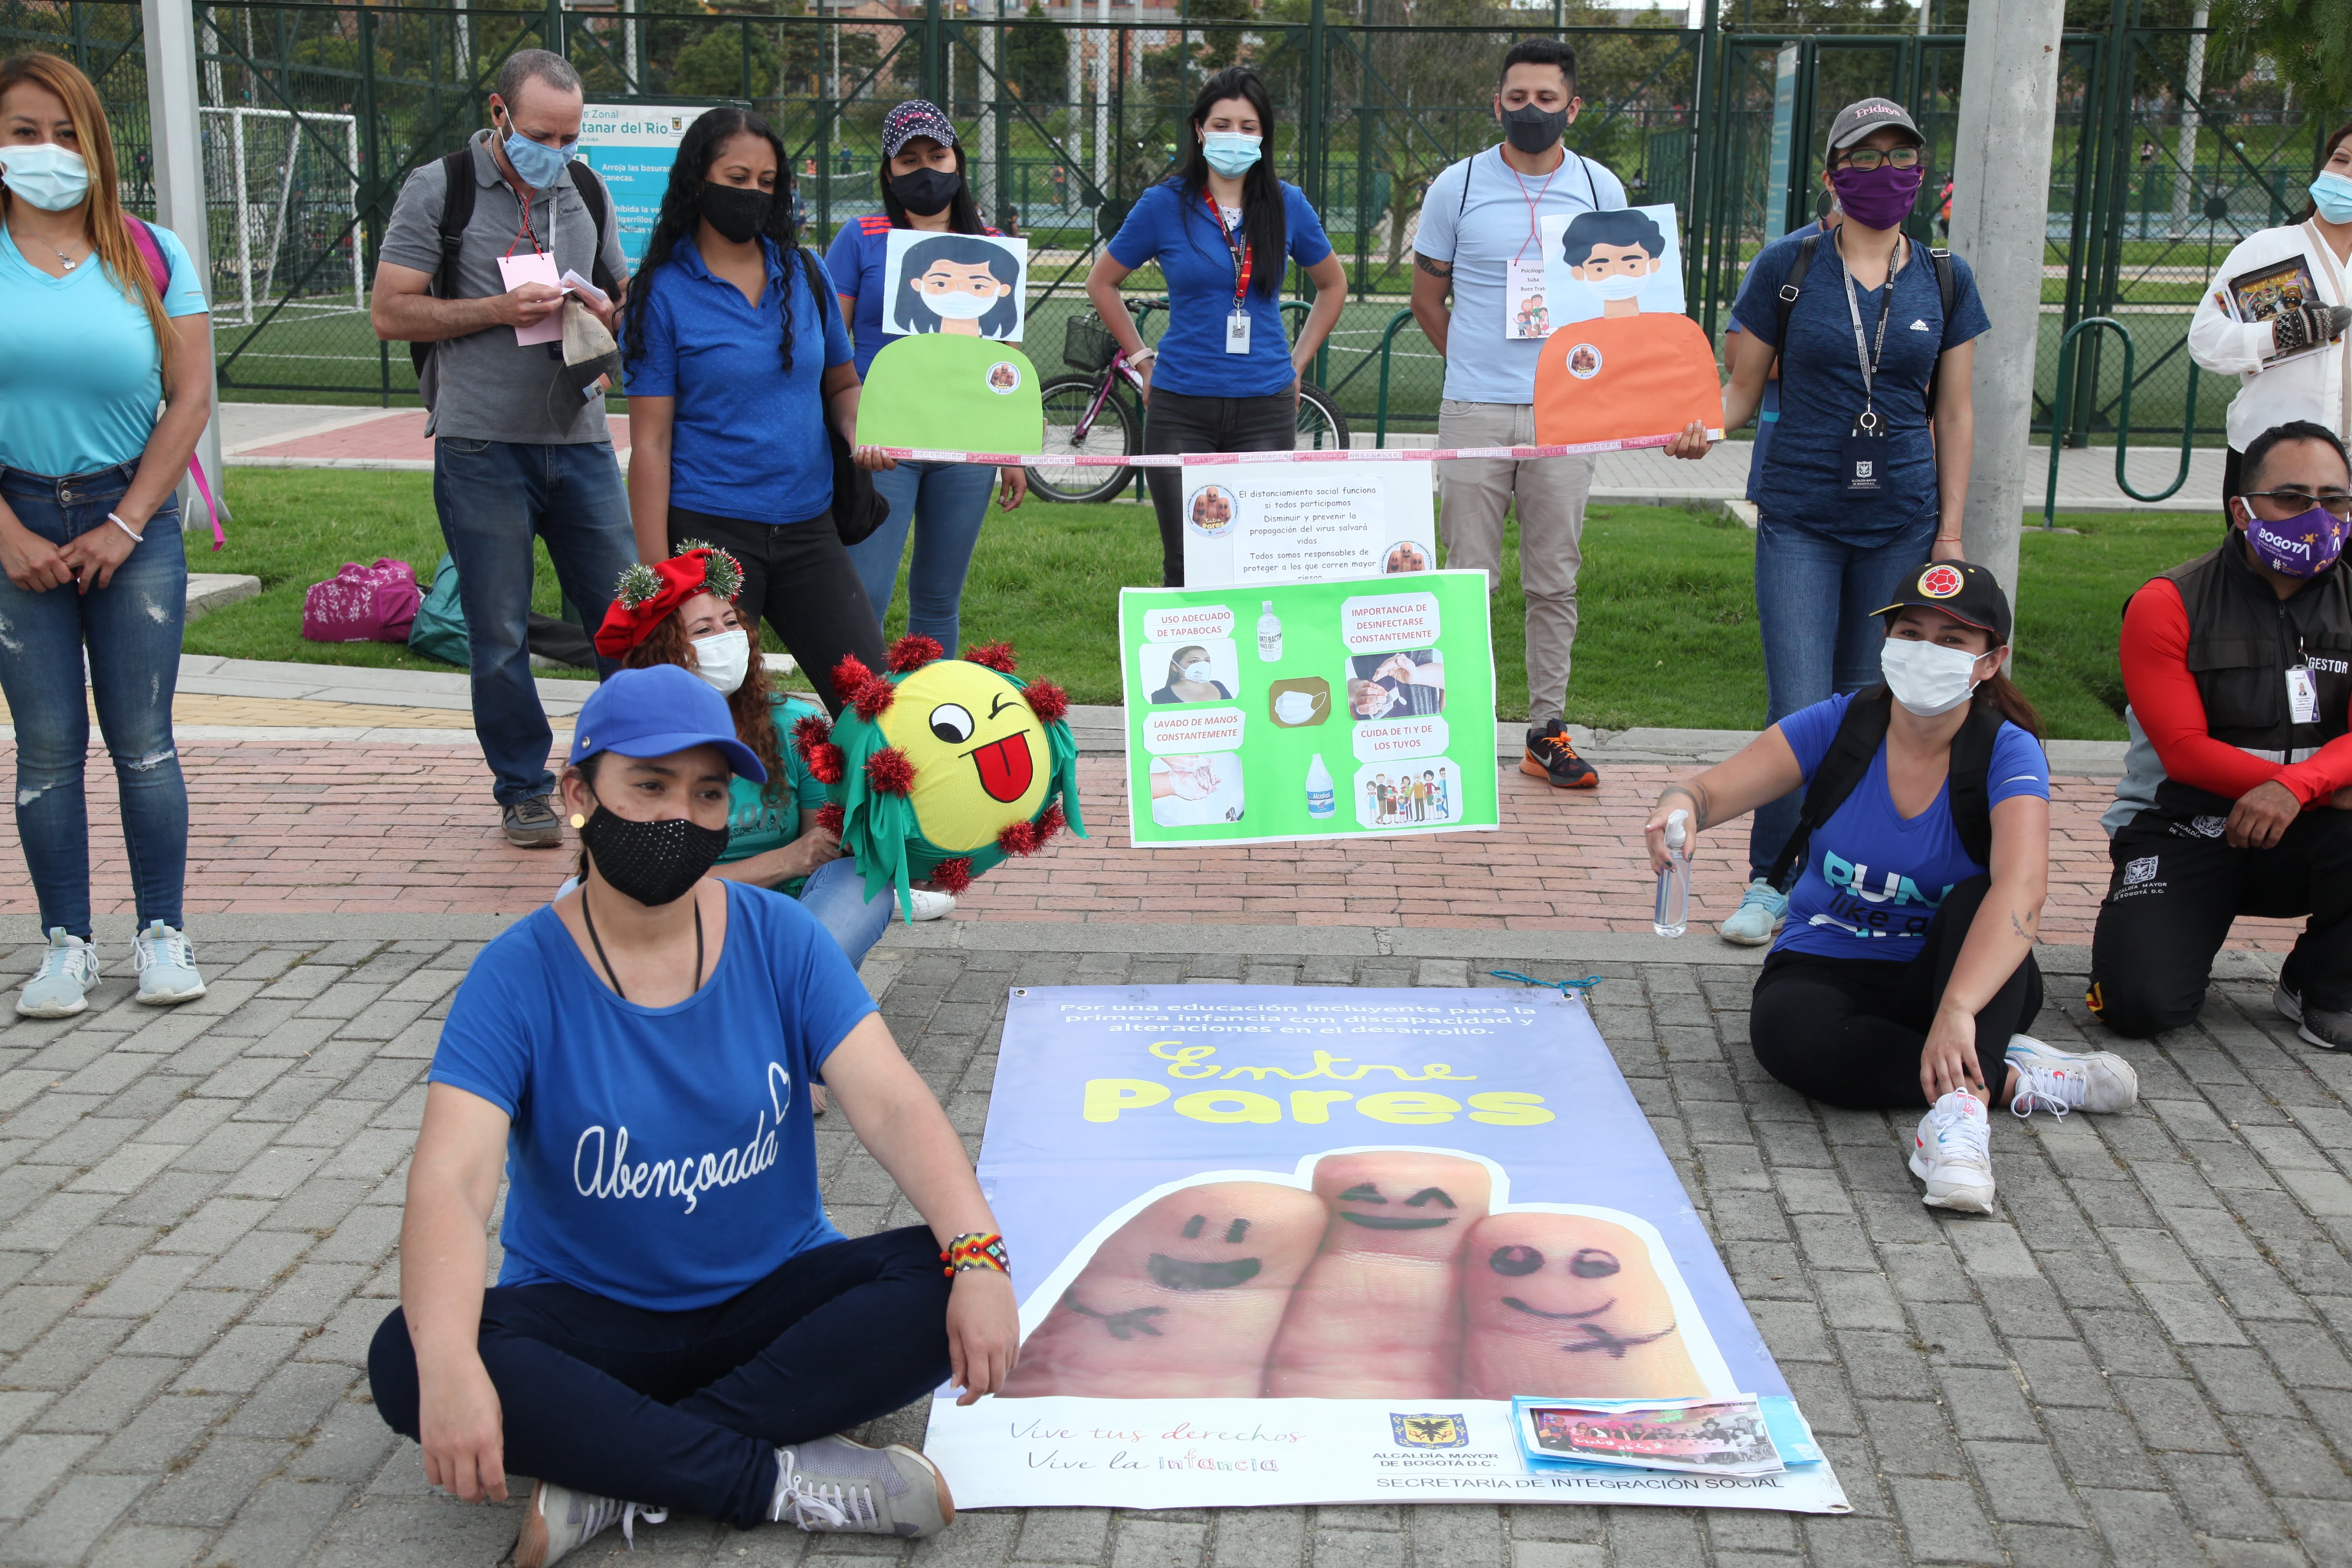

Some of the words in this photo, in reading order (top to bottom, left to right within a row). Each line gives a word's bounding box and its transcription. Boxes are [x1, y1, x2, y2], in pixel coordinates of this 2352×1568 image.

[592, 110, 618, 119] Zonal
[1855, 104, 1900, 120] Fridays
[621, 123, 641, 134] del
[647, 123, 668, 134] Rio
[602, 164, 625, 172] Arroja
[641, 164, 671, 172] basuras
[1250, 488, 1313, 498] distanciamiento
[1316, 487, 1339, 495] social
[1342, 486, 1376, 495] funciona
[1264, 501, 1271, 509] si
[1275, 500, 1297, 509] todos
[1300, 499, 1351, 510] participamos
[1264, 514, 1300, 523] Disminuir
[1312, 513, 1346, 523] prevenir
[1249, 525, 1297, 537] propagación
[1300, 524, 1312, 533] del
[1339, 523, 1368, 532] salvará
[1304, 549, 1356, 559] responsables
[2269, 543, 2281, 553] Distrital
[2279, 553, 2294, 561] Deporte
[1243, 564, 1278, 575] proteger
[1305, 564, 1319, 572] que
[1351, 561, 1376, 570] mayor
[1161, 614, 1180, 624] USO
[1182, 611, 1231, 623] ADECUADO
[1351, 605, 1413, 618] IMPORTANCIA
[1414, 604, 1427, 613] DE
[1357, 617, 1424, 630] DESINFECTARSE
[1157, 628, 1168, 637] DE
[1170, 625, 1222, 636] TAPABOCAS
[1350, 629, 1432, 644] CONSTANTEMENTE
[2308, 657, 2349, 674] GESTOR
[1153, 717, 1189, 729] LAVADO
[1191, 716, 1204, 726] DE
[1206, 714, 1238, 725] MANOS
[1156, 728, 1237, 741] CONSTANTEMENTE
[1361, 728, 1387, 738] CUIDA
[1389, 727, 1402, 736] DE
[1403, 726, 1411, 735] TI
[1413, 726, 1419, 735] Y
[1421, 724, 1433, 734] DE
[1374, 740, 1392, 750] LOS
[1394, 739, 1421, 749] TUYOS
[2169, 827, 2177, 835] DE
[2173, 822, 2200, 839] ALCALDÍA
[1824, 850, 1954, 908] RUN
[2114, 884, 2138, 897] ALCALDÍA
[2120, 889, 2147, 899] BOGOTÁ
[1829, 892, 1889, 927] like
[1905, 916, 1929, 933] a
[1167, 1003, 1298, 1012] educación
[1306, 1005, 1441, 1014] incluyente
[1448, 1007, 1507, 1015] para
[1514, 1007, 1537, 1015] la
[1065, 1014, 1169, 1023] primera
[1178, 1014, 1281, 1022] infancia
[1344, 1015, 1512, 1025] discapacidad
[1519, 1018, 1534, 1026] y
[1109, 1023, 1272, 1033] alteraciones
[1280, 1026, 1311, 1034] en
[1351, 1025, 1494, 1035] desarrollo.
[1148, 1040, 1478, 1081] Entre
[1083, 1078, 1555, 1125] Pares
[1010, 1418, 1079, 1439] Vive
[1089, 1426, 1149, 1443] tus
[1161, 1422, 1306, 1443] derechos
[1029, 1449, 1098, 1470] Vive
[1109, 1451, 1151, 1470] la
[1159, 1448, 1279, 1472] infancia
[1376, 1477, 1511, 1488] SECRETARÍA
[1516, 1480, 1545, 1488] DE
[1552, 1478, 1698, 1490] INTEGRACIÓN
[1705, 1478, 1785, 1488] SOCIAL
